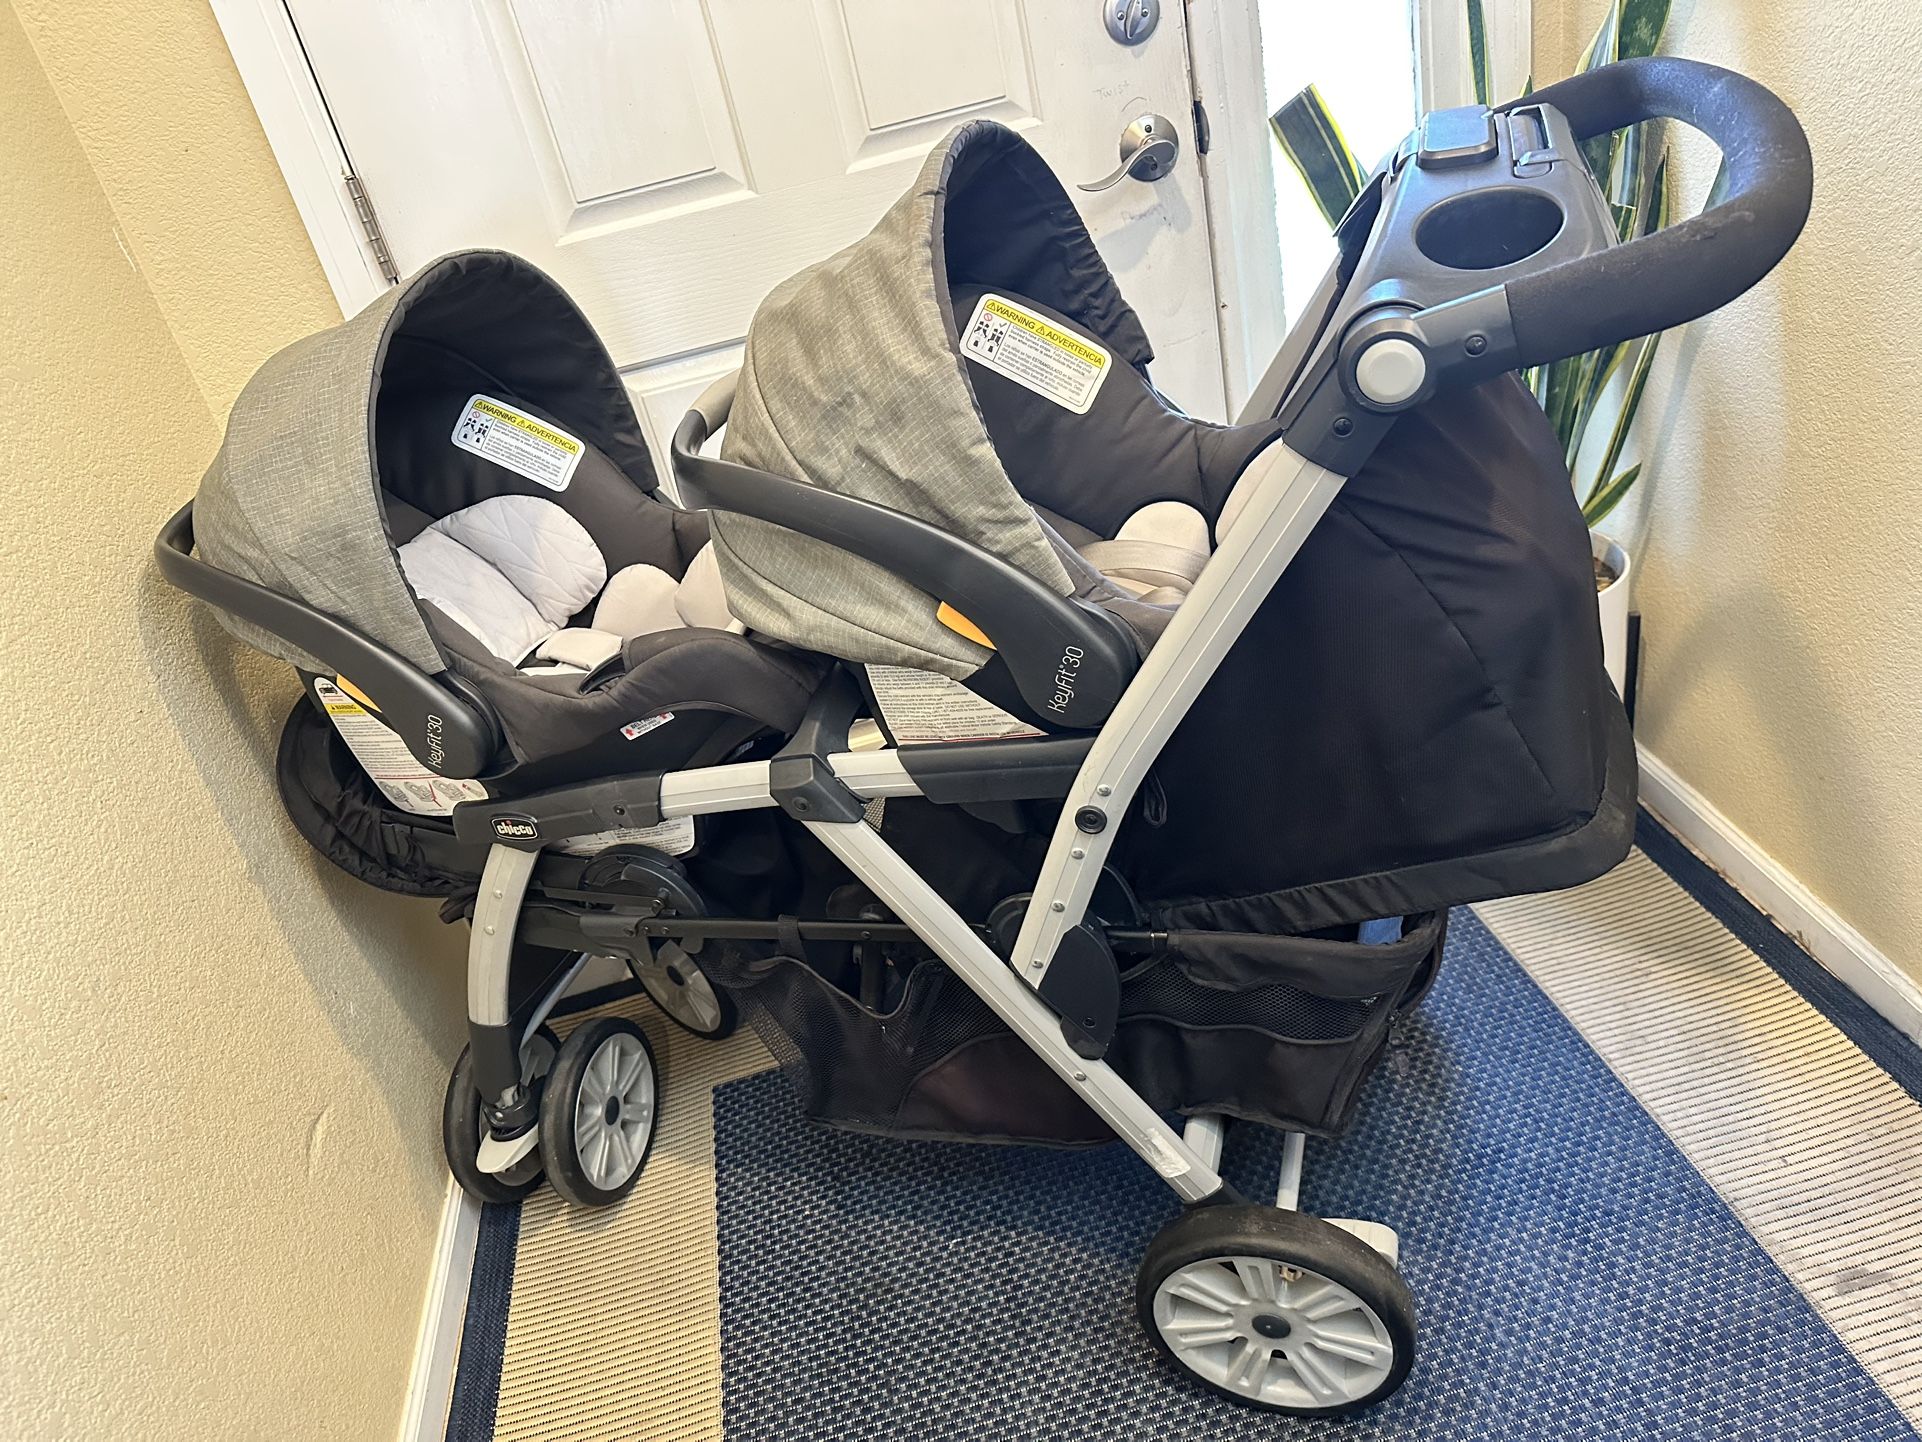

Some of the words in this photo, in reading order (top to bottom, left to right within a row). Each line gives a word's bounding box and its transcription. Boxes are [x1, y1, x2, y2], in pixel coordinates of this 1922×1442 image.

[995, 305, 1035, 330] WARNING
[1045, 331, 1102, 365] ADVERTENCIA
[482, 403, 517, 424] WARNING
[525, 423, 576, 453] ADVERTENCIA
[1062, 646, 1084, 668] 30
[427, 714, 443, 733] 30
[496, 820, 534, 835] chicco
